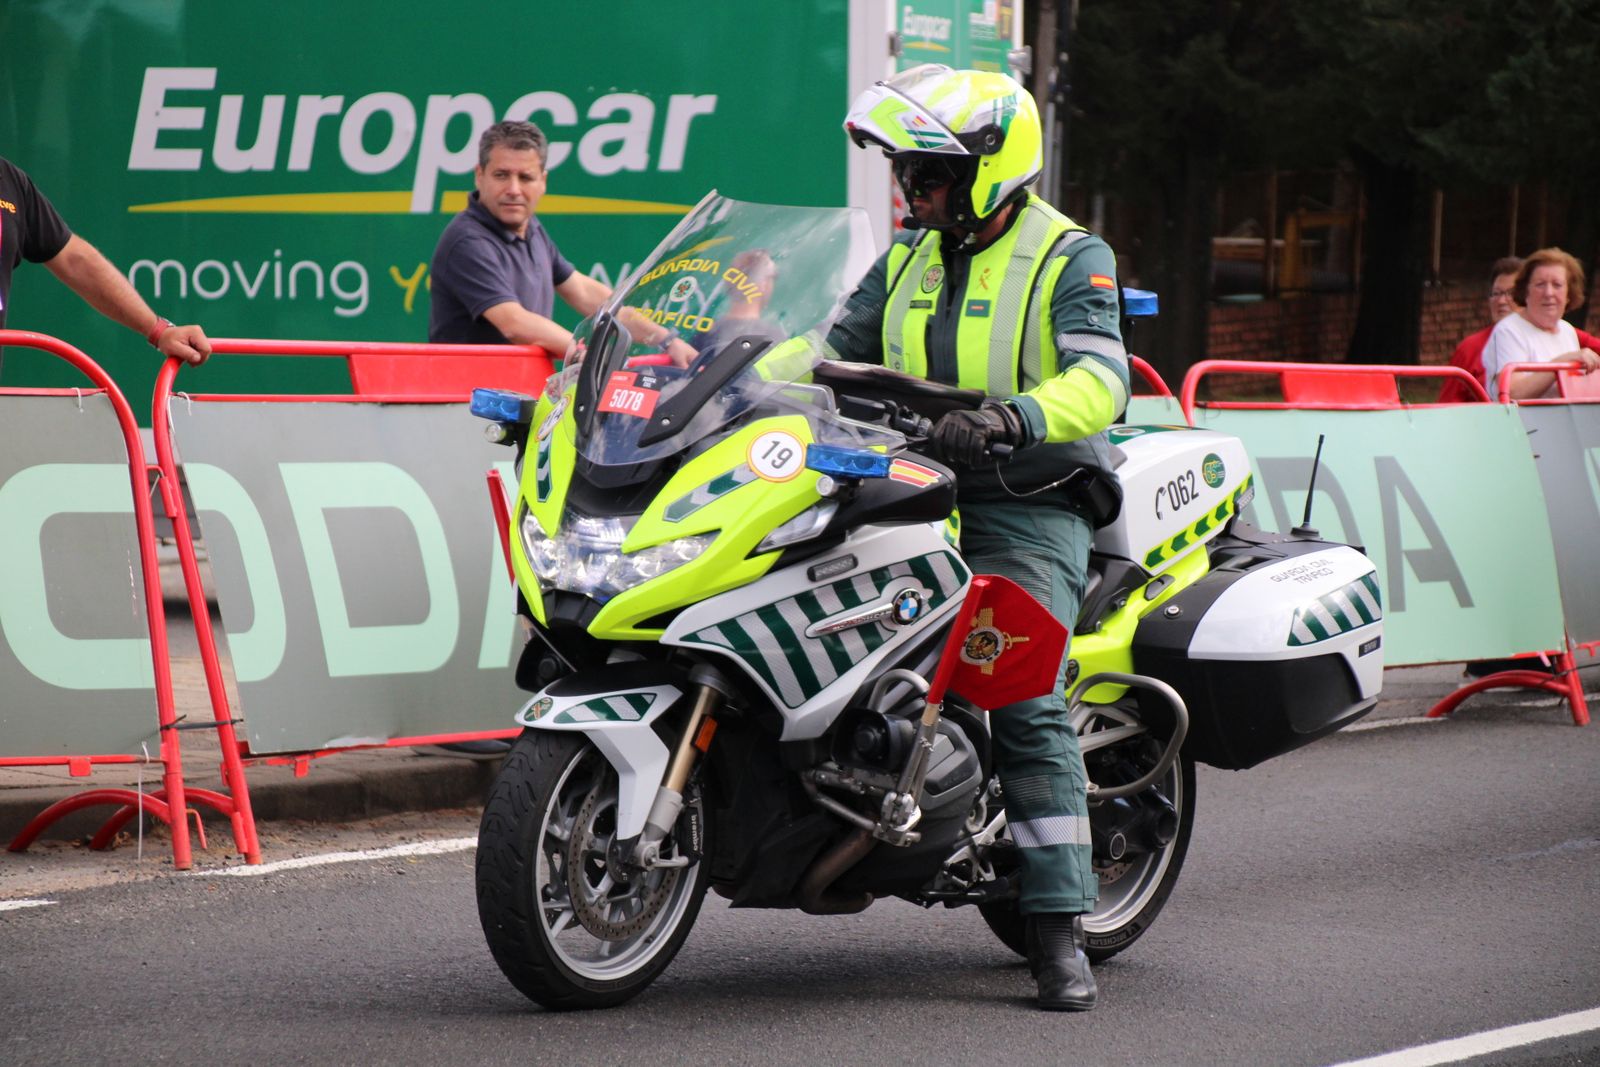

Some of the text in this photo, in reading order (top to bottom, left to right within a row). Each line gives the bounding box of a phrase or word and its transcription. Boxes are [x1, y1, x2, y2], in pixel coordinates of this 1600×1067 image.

[127, 66, 717, 213] Europcar
[128, 250, 370, 316] moving
[638, 258, 720, 286] GUARDIA
[722, 267, 763, 304] CIVIL
[609, 388, 645, 411] 5078
[761, 440, 793, 469] 19
[1167, 469, 1199, 511] 062
[0, 462, 519, 690] OD
[691, 814, 699, 851] brembo
